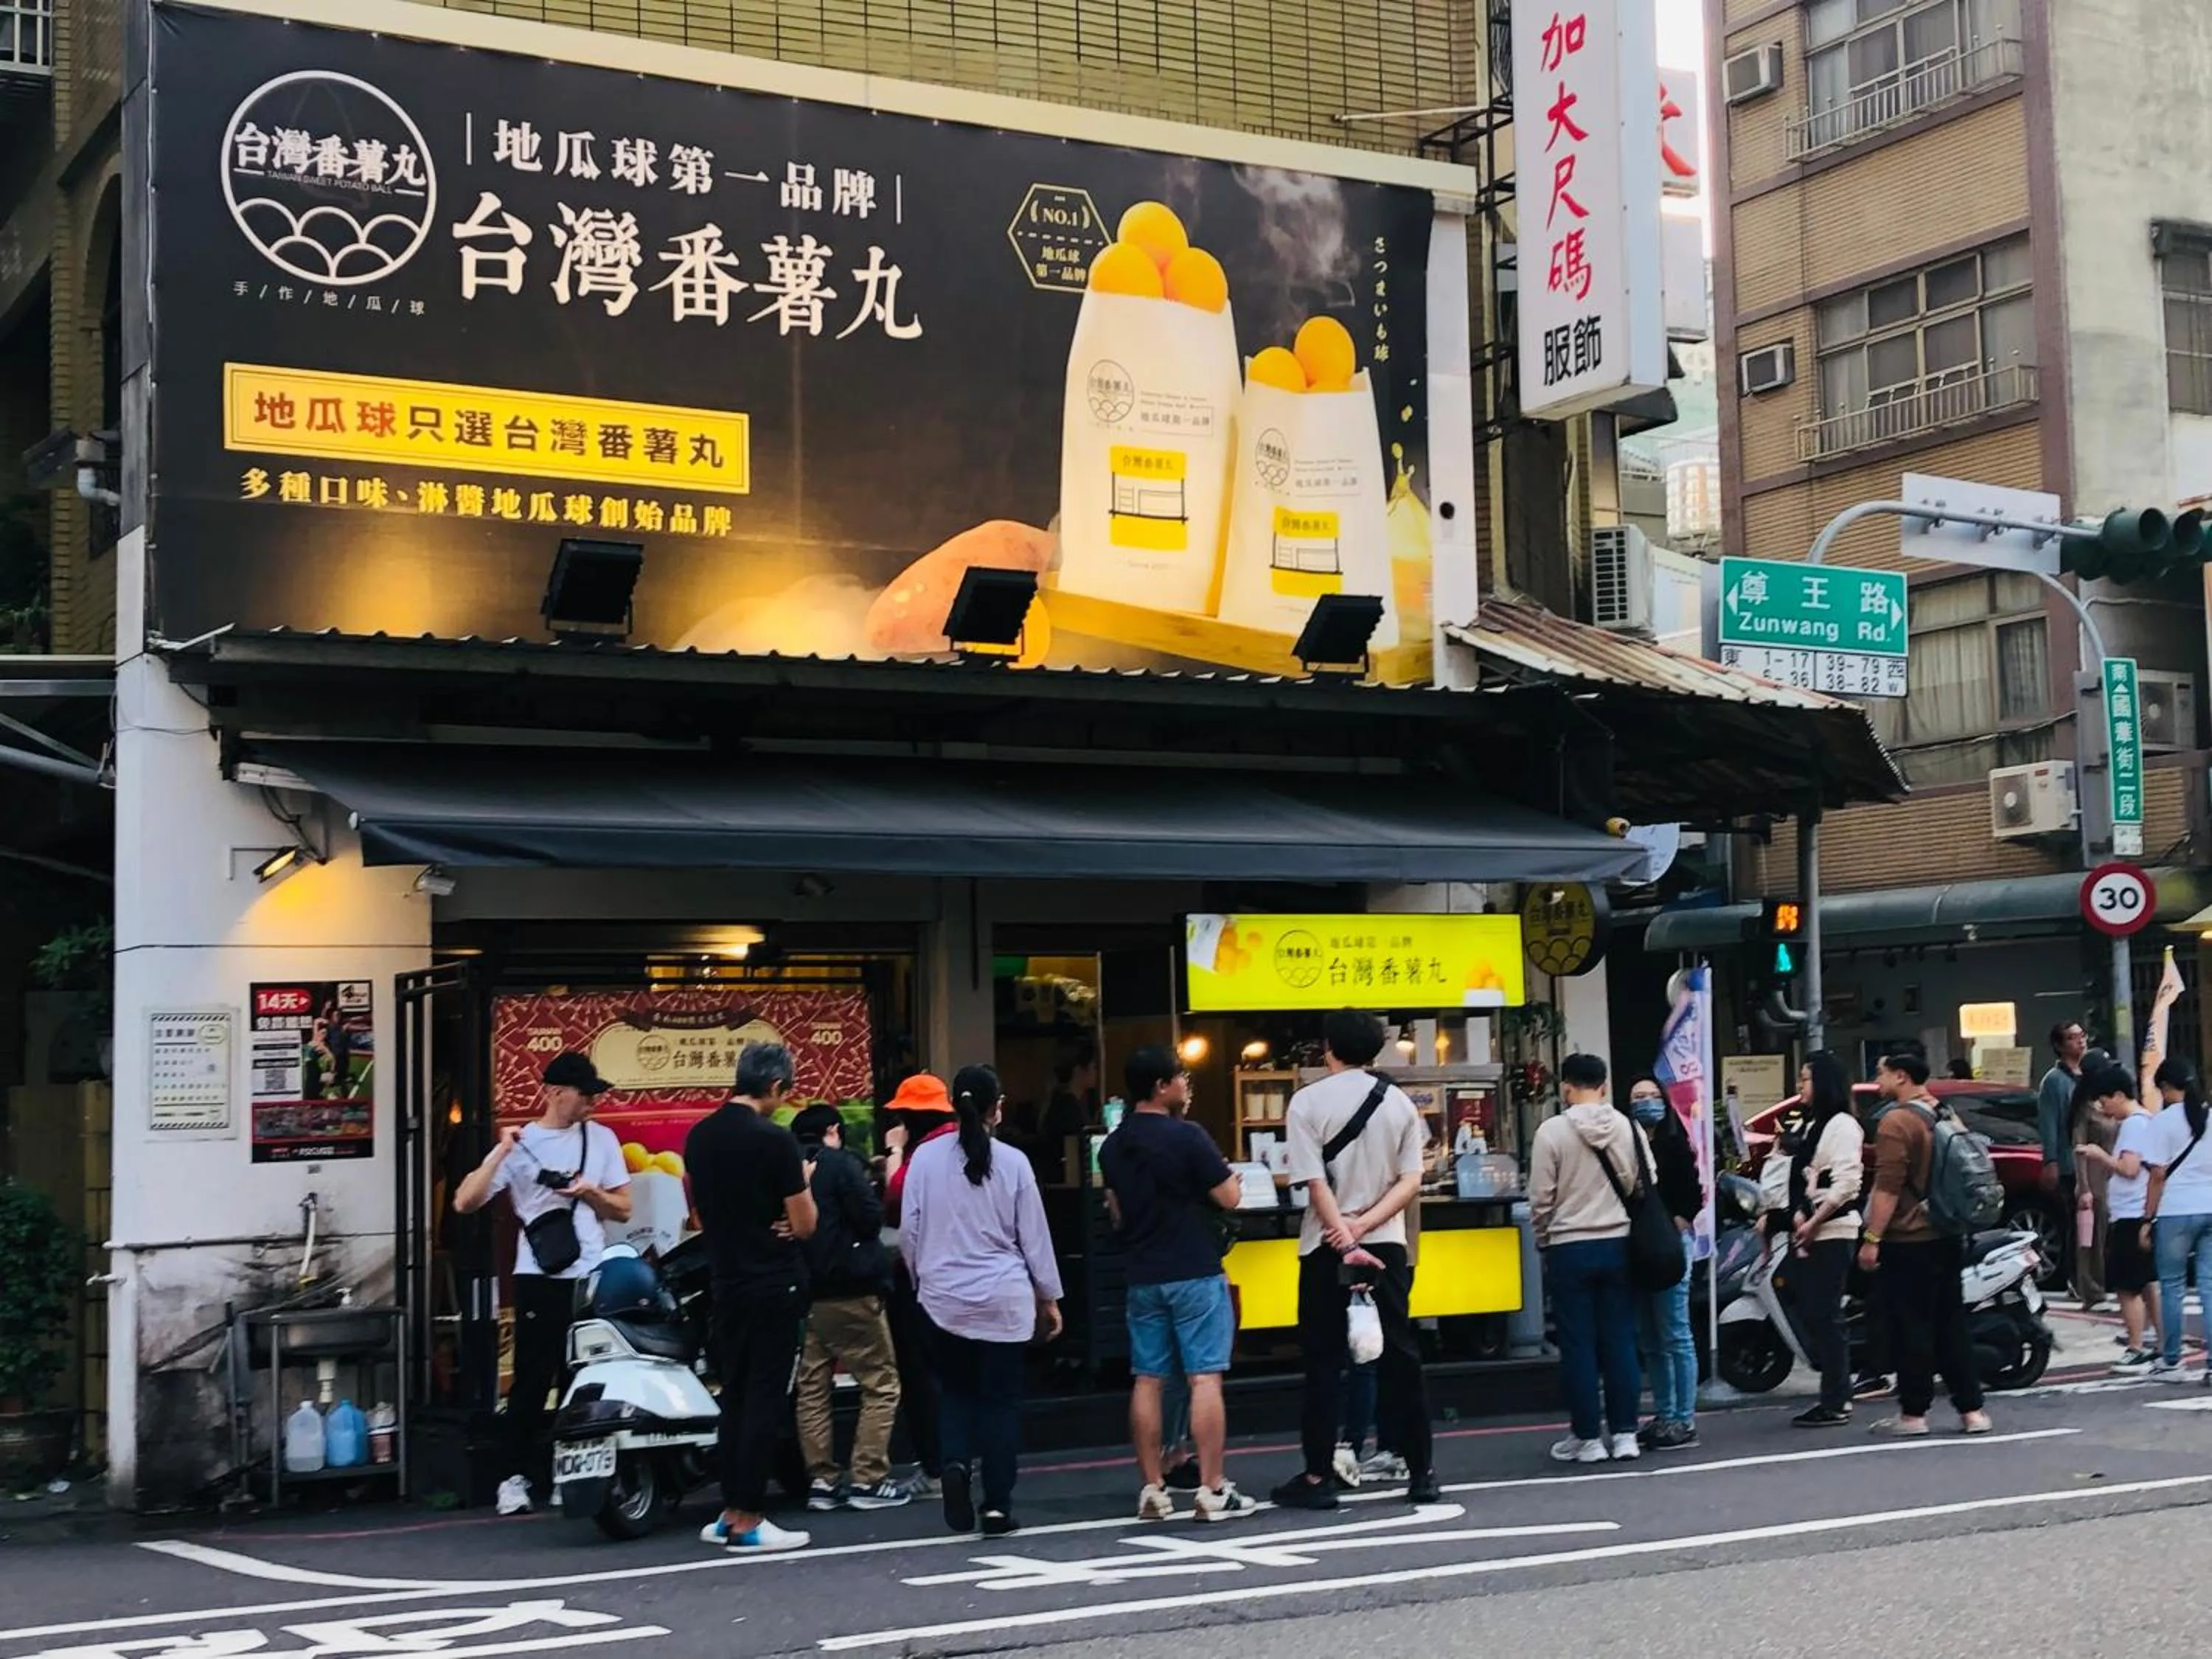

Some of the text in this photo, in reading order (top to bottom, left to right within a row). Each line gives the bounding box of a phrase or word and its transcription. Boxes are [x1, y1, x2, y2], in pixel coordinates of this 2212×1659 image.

[234, 122, 426, 186] 台灣番薯丸
[493, 119, 877, 219] 地瓜球第一品牌
[1541, 12, 1592, 301] 加大尺碼
[1043, 207, 1078, 226] NO.1
[452, 192, 923, 340] 台灣番薯丸
[1373, 236, 1390, 363] さつまいも球
[1543, 315, 1602, 386] 服飾
[254, 391, 724, 469] 地瓜球只選台灣番薯丸
[1739, 570, 1890, 614] 尊王路
[1739, 612, 1891, 642] Zunwang Rd.
[2099, 887, 2139, 910] 30
[1329, 957, 1447, 987] 台灣番薯丸
[254, 993, 299, 1011] 14天
[527, 1036, 563, 1052] 400
[810, 1030, 843, 1046] 400
